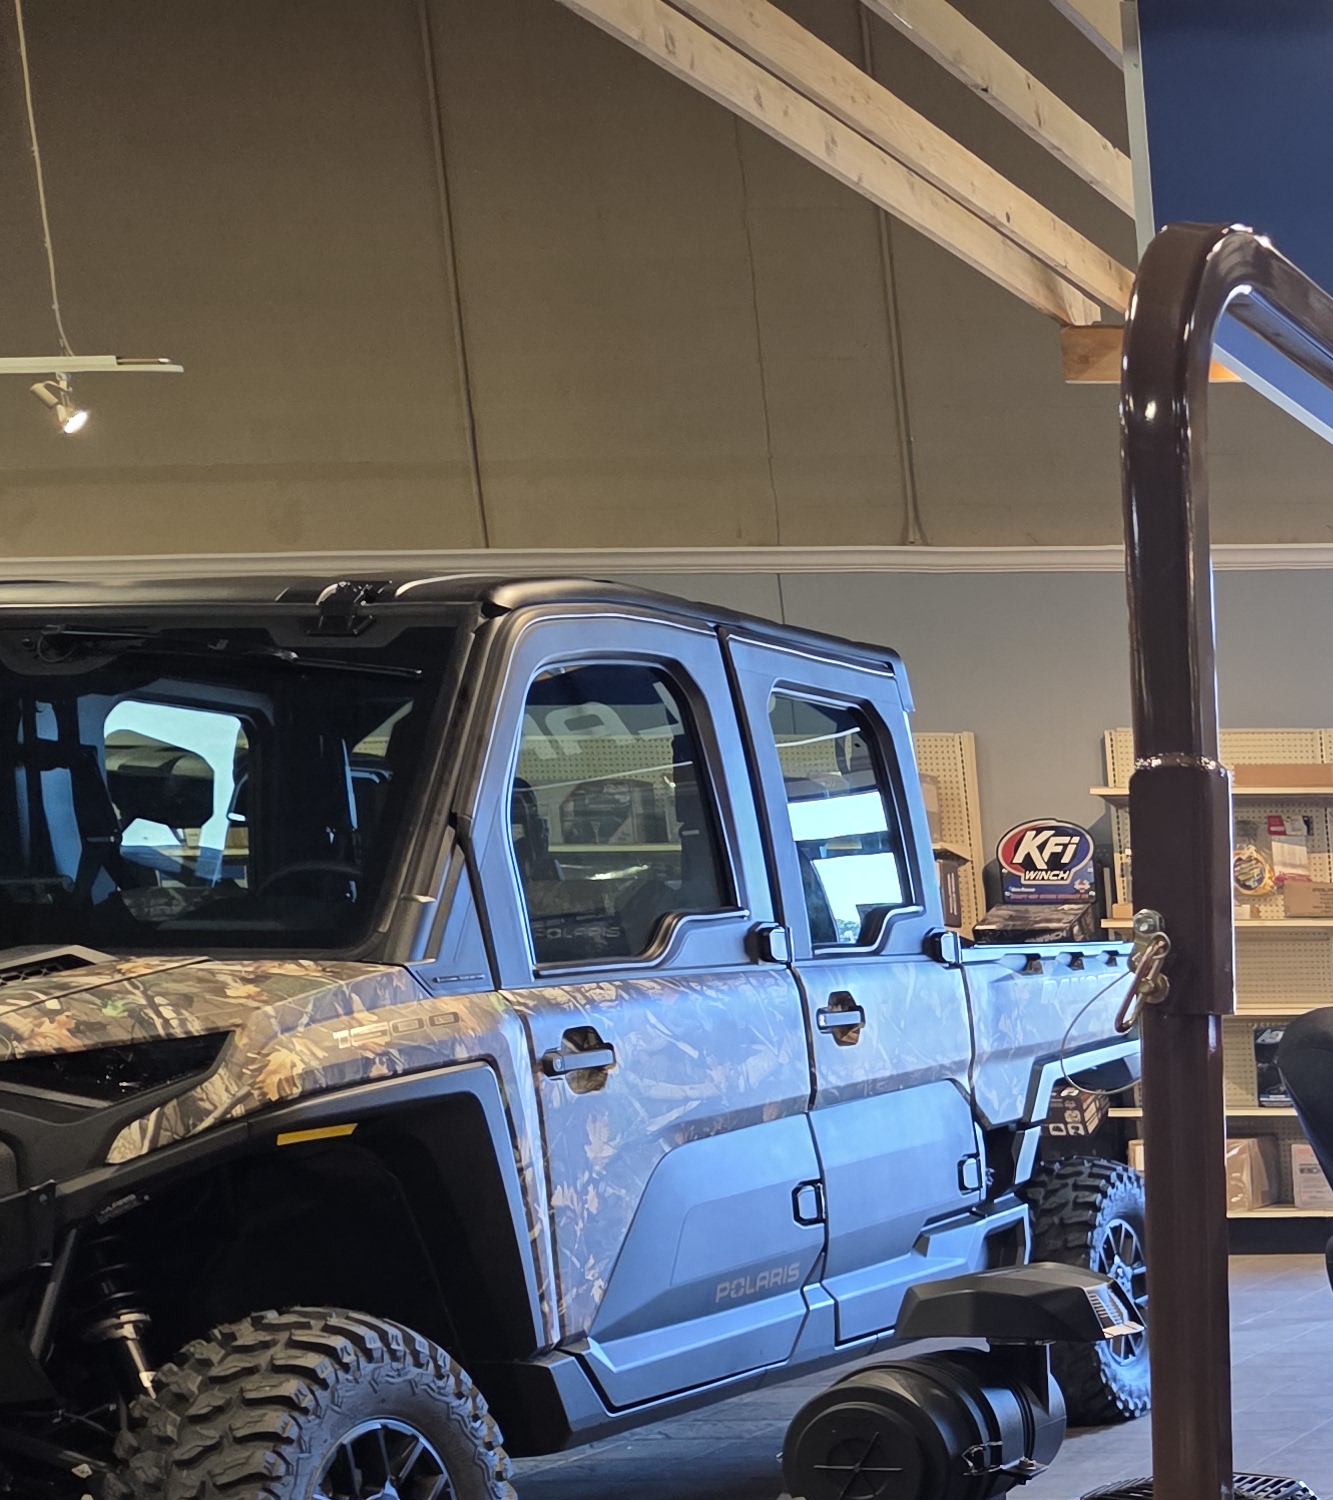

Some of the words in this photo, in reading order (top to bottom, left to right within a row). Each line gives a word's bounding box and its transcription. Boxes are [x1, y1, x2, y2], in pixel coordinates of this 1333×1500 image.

[1025, 870, 1070, 880] WINCH
[332, 1011, 460, 1049] 1500
[715, 1262, 800, 1303] POLARIS
